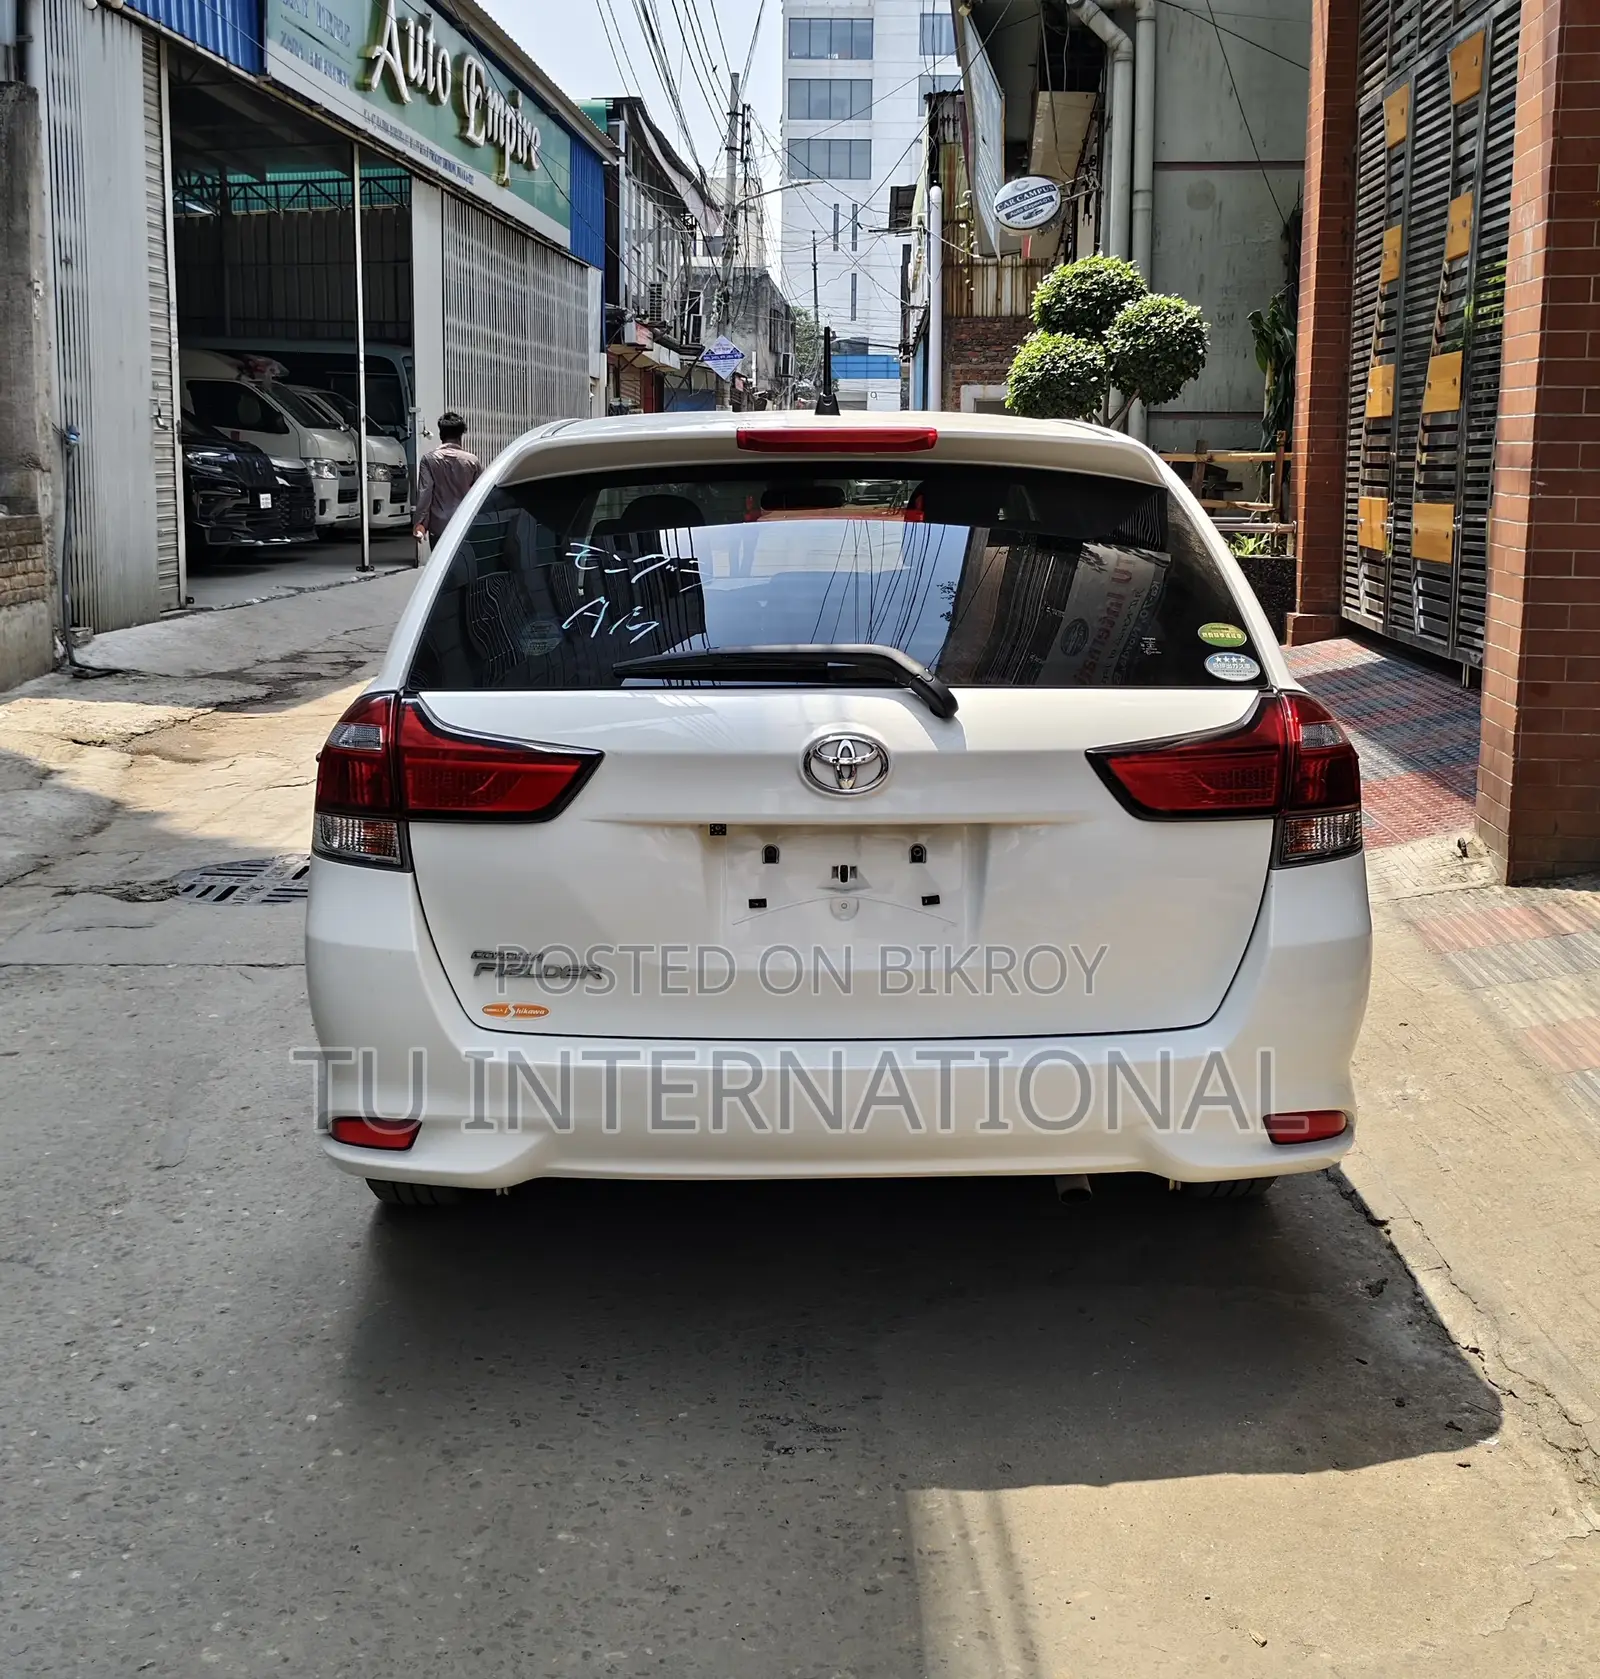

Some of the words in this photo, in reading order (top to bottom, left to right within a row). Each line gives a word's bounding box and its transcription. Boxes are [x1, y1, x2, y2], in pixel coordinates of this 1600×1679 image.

[371, 0, 451, 106] Auto
[462, 54, 542, 182] Empire
[996, 198, 1015, 211] CAR
[1016, 184, 1055, 202] CAMPUS
[473, 962, 602, 980] FIELDER
